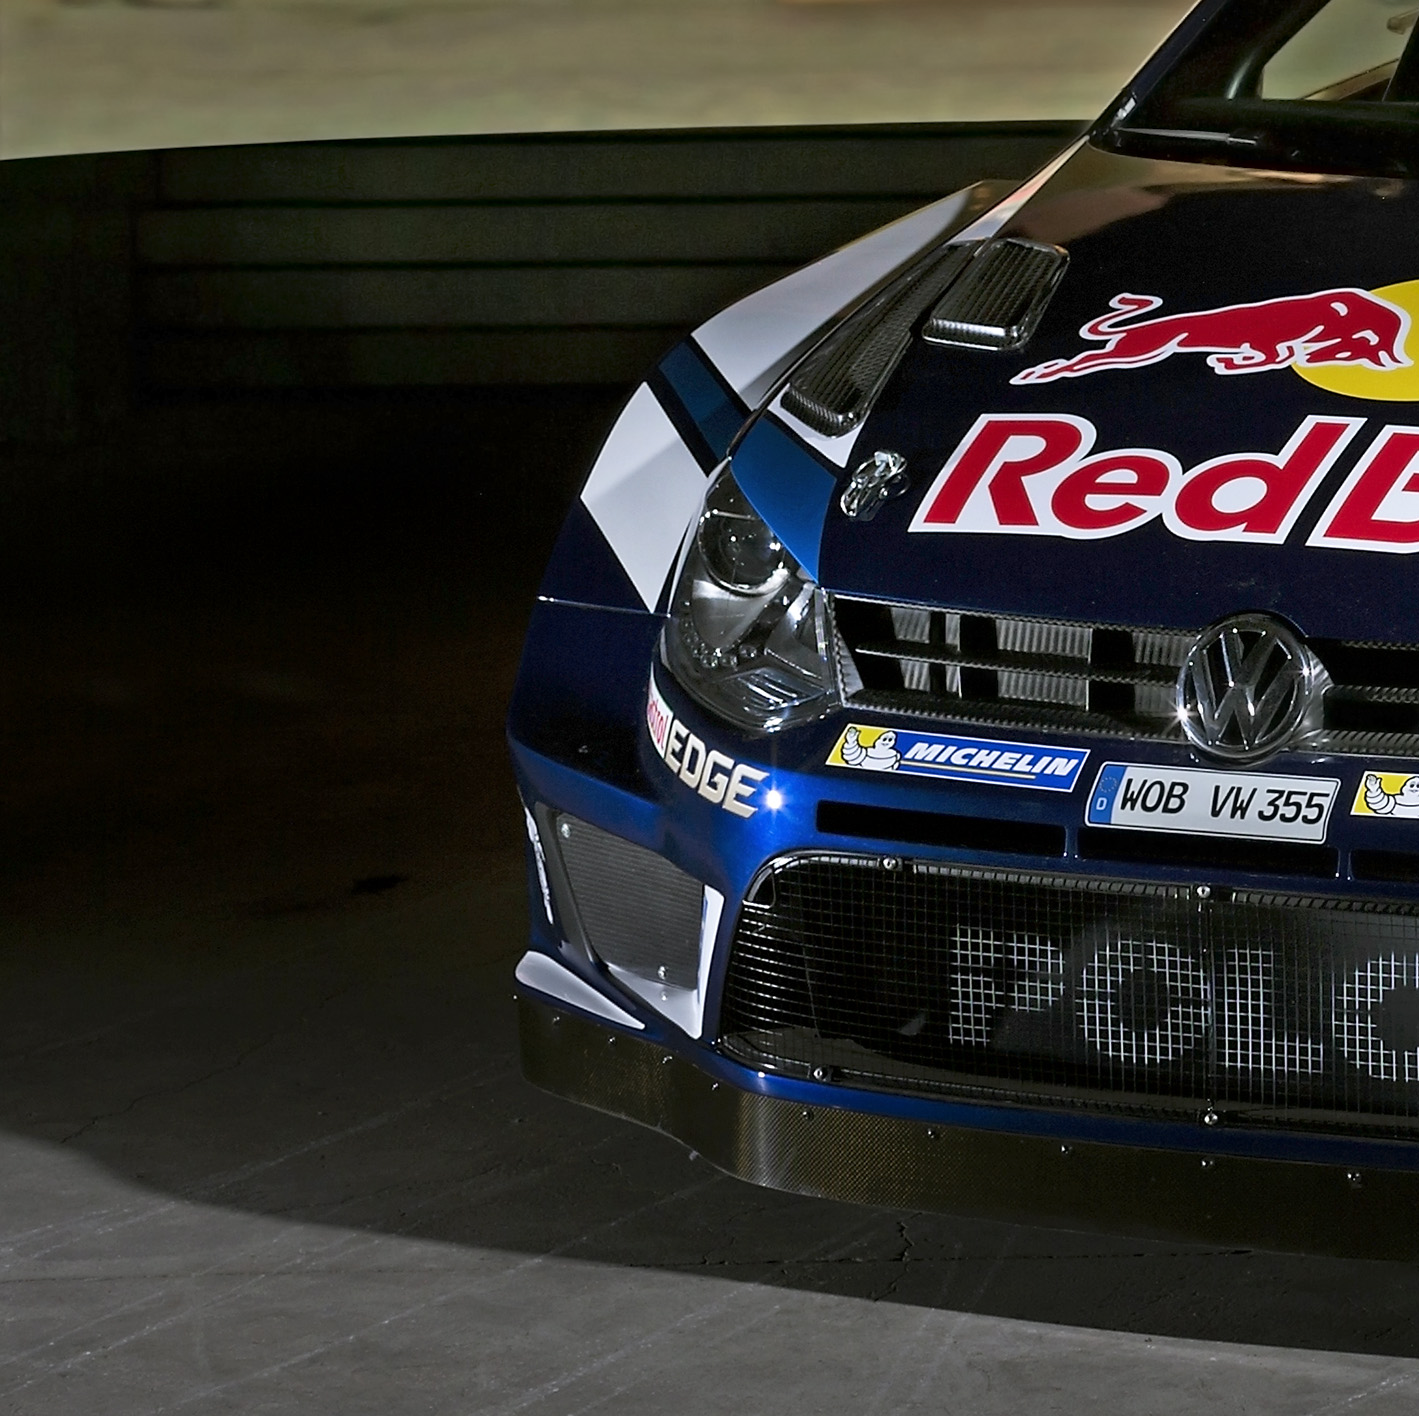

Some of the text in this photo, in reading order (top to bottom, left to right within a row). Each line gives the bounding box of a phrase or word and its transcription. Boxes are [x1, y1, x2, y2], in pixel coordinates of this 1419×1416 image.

[924, 419, 1350, 535] Red
[665, 719, 770, 818] EDGE
[903, 742, 1079, 776] MICHELIN
[1096, 774, 1330, 825] D WOB VW 355
